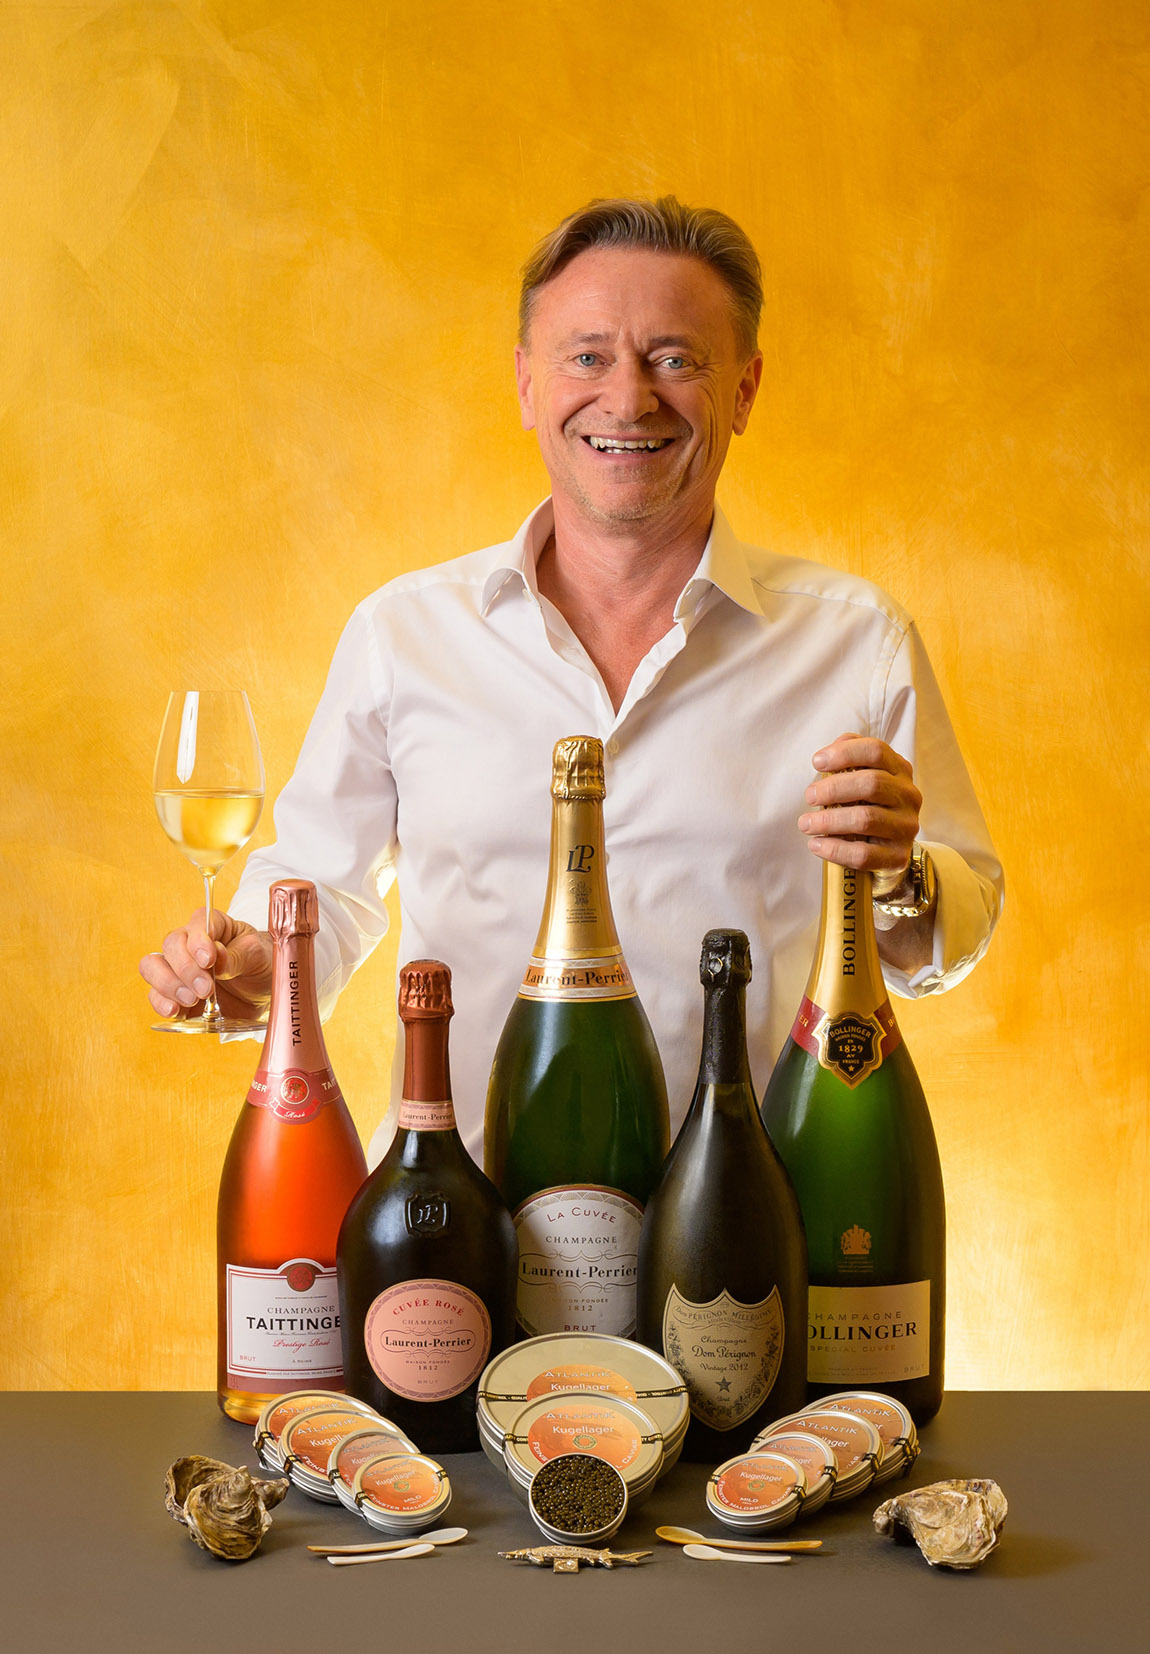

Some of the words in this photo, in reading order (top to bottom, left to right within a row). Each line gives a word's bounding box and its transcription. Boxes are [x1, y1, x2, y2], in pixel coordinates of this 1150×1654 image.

[843, 867, 856, 976] BOLLINGE
[289, 960, 300, 1047] TAITTINGER
[829, 1025, 872, 1038] BOLLINGER
[839, 1044, 864, 1053] 1829
[545, 1235, 618, 1244] CHAMPAGNE
[267, 1305, 336, 1315] CHAMPAGNE
[392, 1297, 430, 1316] CUVÉE
[435, 1299, 465, 1317] ROSÉ
[568, 1304, 593, 1312] 1812
[246, 1316, 341, 1331] TAITTINGE
[564, 1324, 597, 1332] BRUT
[807, 1321, 917, 1341] OLLINGER
[272, 1338, 307, 1353] Prestige
[308, 1338, 331, 1347] Rosé
[385, 1336, 472, 1348] Laurent-Perrier
[700, 1335, 747, 1346] Champagne
[239, 1354, 256, 1362] BRUT
[691, 1344, 716, 1358] Dom
[716, 1346, 757, 1362] Pérignon
[700, 1362, 727, 1373] Vintage
[728, 1363, 749, 1371] 2012
[904, 1363, 926, 1374] BRUT
[545, 1412, 615, 1420] ATLANTIK
[830, 1403, 892, 1417] ATLANTIK
[297, 1417, 357, 1435] ATLANTIK
[552, 1426, 615, 1435] Kugellager
[796, 1420, 859, 1435] ATLANTIK
[309, 1434, 345, 1447] Kugell
[375, 1470, 416, 1487] Kugellager
[740, 1471, 783, 1483] Kugellager
